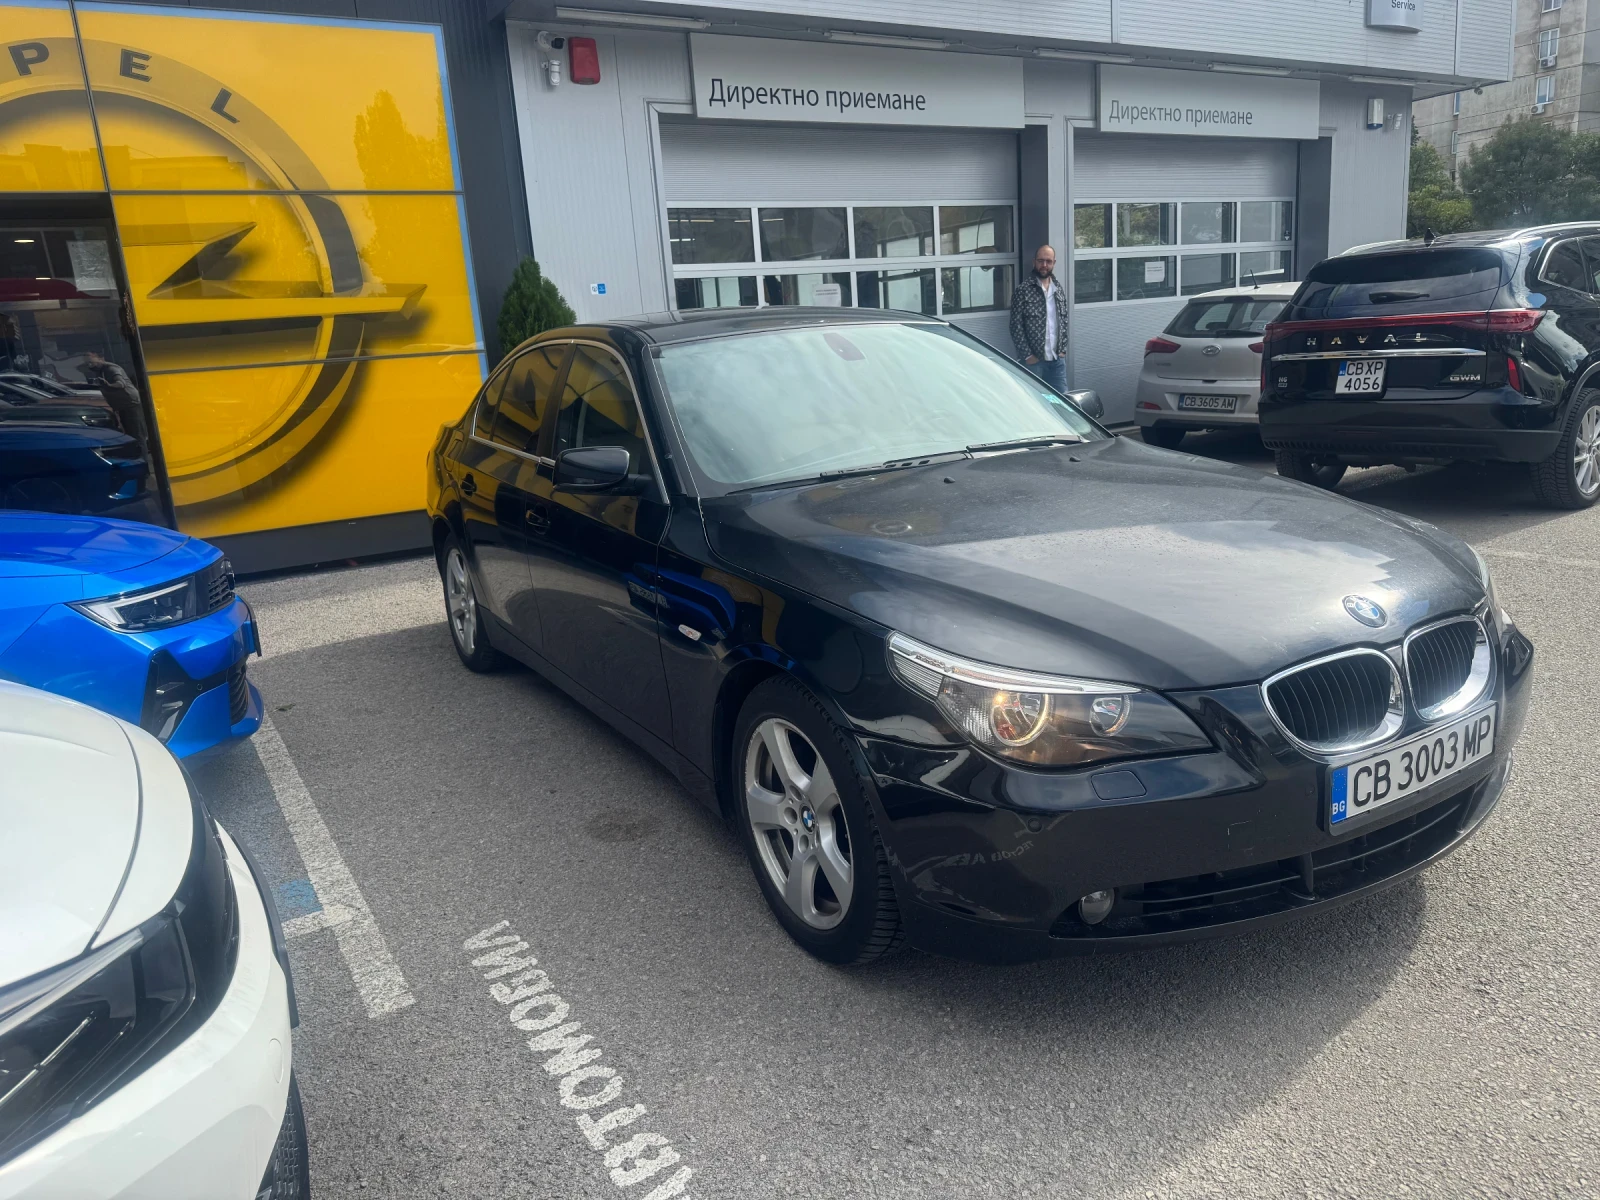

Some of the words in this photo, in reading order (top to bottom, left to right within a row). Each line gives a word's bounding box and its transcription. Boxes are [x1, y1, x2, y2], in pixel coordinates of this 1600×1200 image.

[1391, 0, 1416, 11] Service
[708, 78, 820, 110] Директно
[825, 90, 927, 114] приемане
[1108, 99, 1182, 125] Директно
[1185, 108, 1253, 128] приемане
[1306, 332, 1427, 346] HAVAL
[1346, 361, 1364, 376] CB
[1365, 361, 1384, 376] XP
[1344, 377, 1380, 391] 4056
[1184, 396, 1196, 408] CB
[1197, 396, 1220, 409] 3605
[1220, 398, 1235, 410] AM
[1353, 759, 1392, 808] CB
[1398, 730, 1459, 791] 3003
[1462, 714, 1492, 762] MP
[1332, 800, 1346, 816] BG
